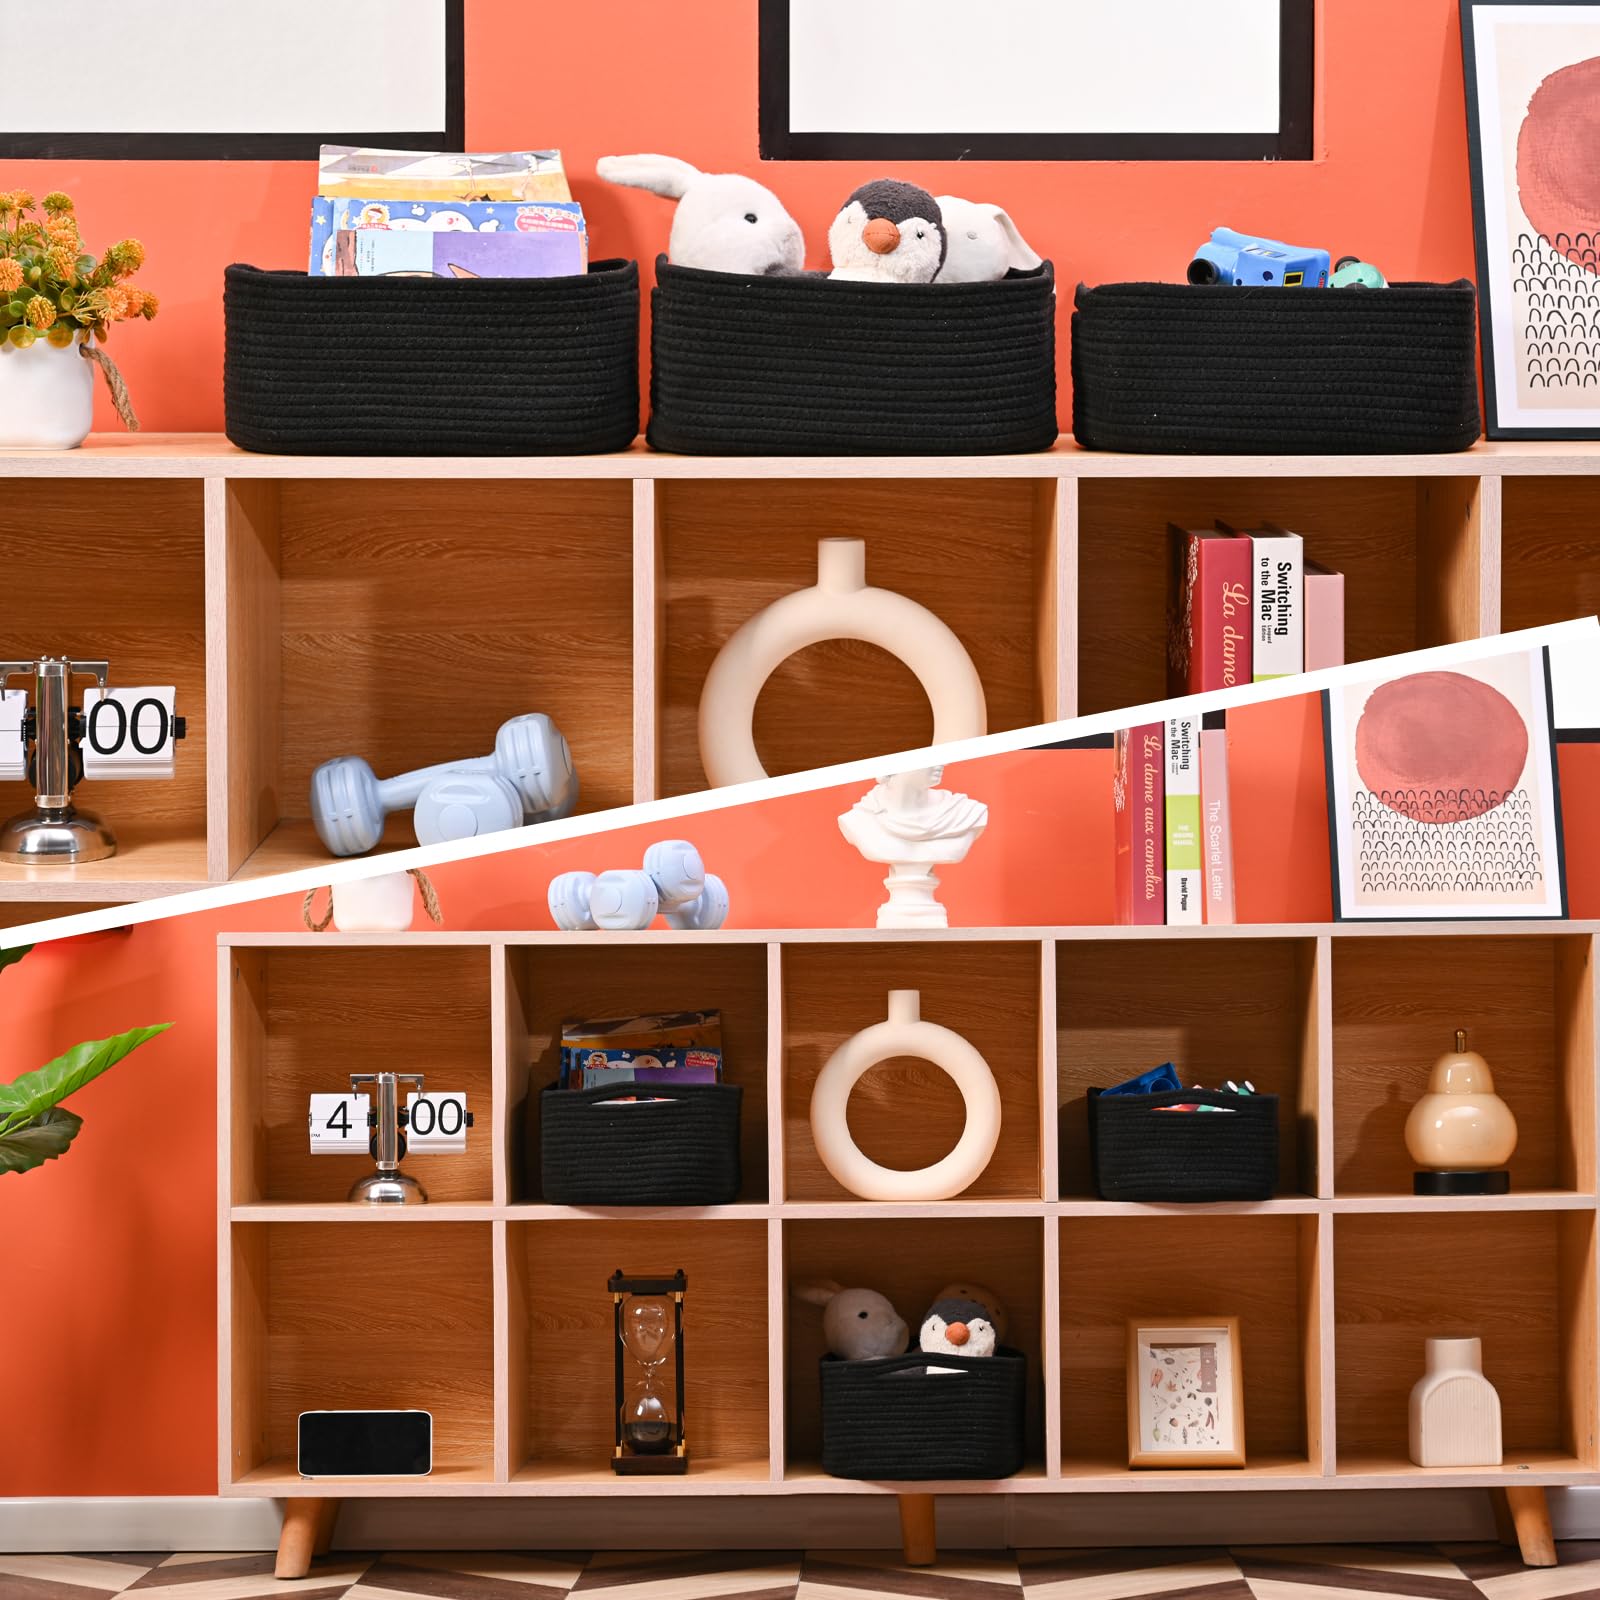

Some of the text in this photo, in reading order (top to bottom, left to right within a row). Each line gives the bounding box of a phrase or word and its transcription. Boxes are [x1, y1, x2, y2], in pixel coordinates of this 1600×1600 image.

[1261, 557, 1276, 621] to the Mac
[1274, 562, 1292, 636] Switching
[1223, 582, 1249, 687] La dame
[88, 698, 168, 755] 00
[1171, 740, 1180, 760] Mac
[1180, 722, 1191, 770] Switching
[1144, 735, 1162, 901] La dame aux camelias
[1209, 800, 1223, 901] The Scarlet Letter
[326, 1099, 463, 1138] 4 00
